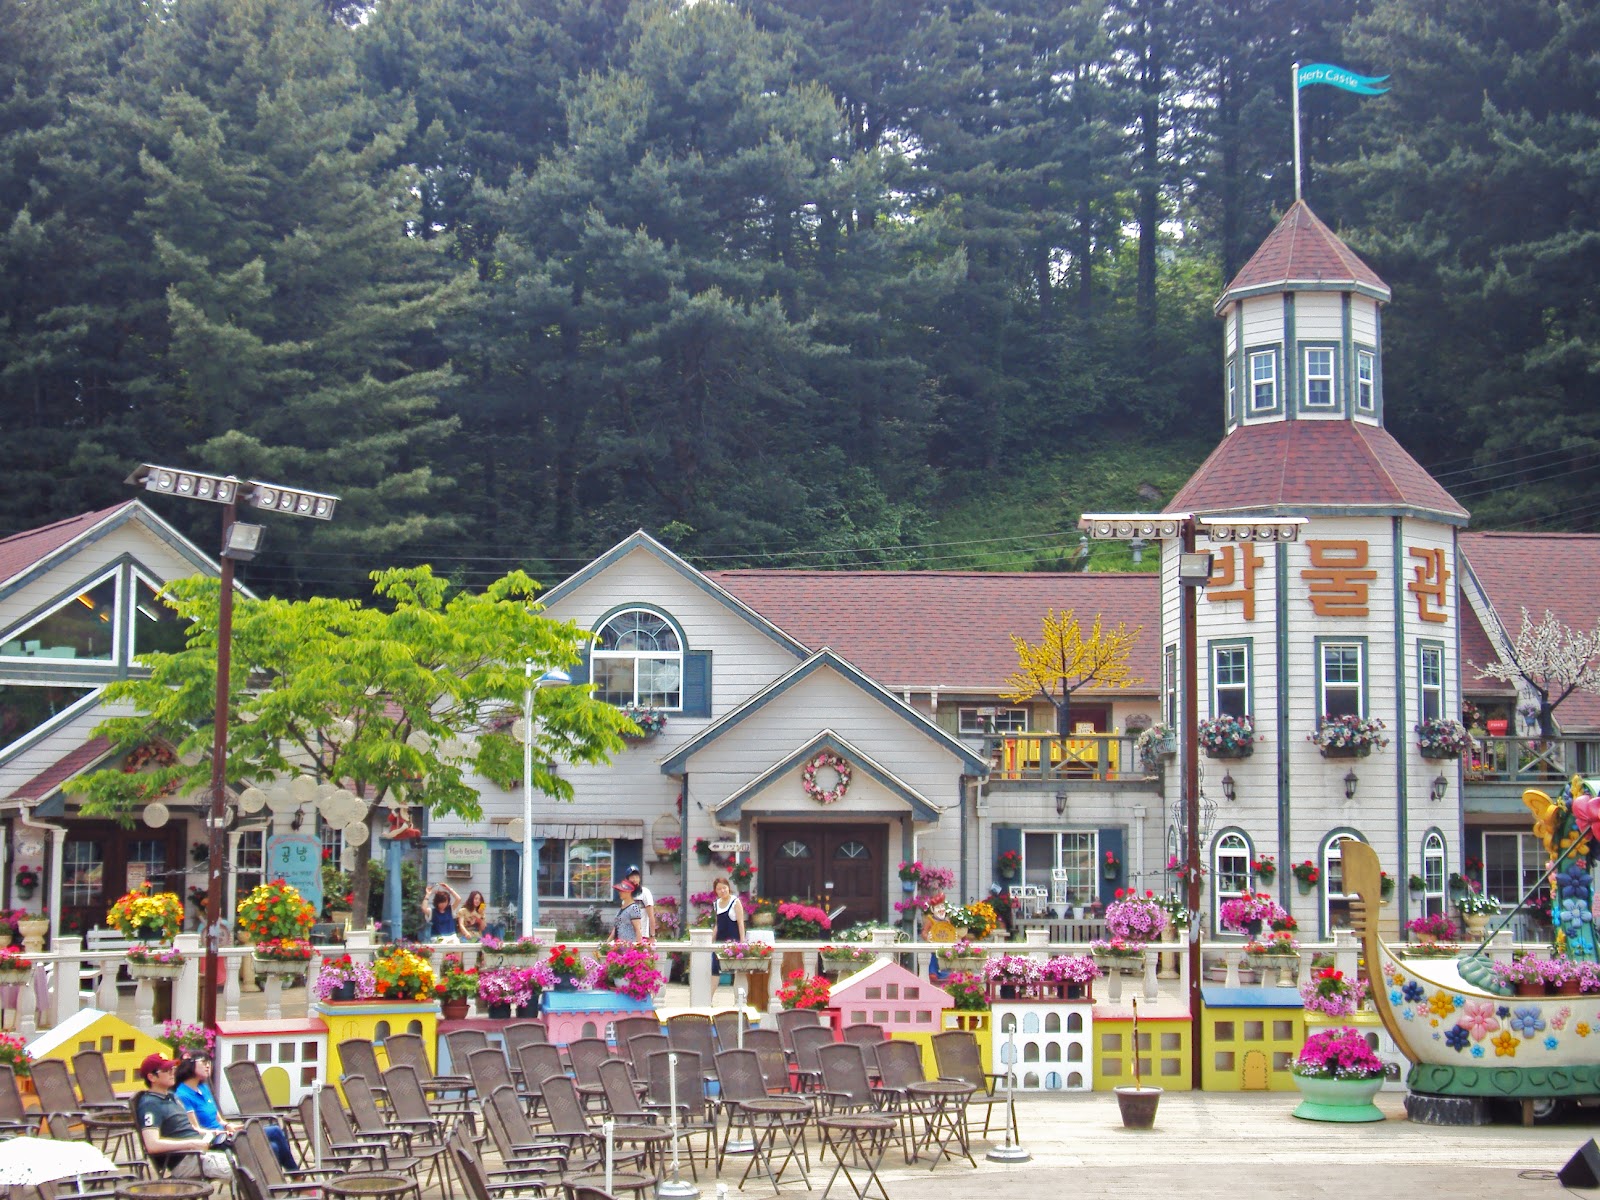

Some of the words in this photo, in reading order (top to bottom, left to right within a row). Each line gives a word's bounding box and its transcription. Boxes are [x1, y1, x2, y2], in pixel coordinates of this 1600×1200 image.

[1300, 69, 1323, 82] Herb
[1325, 70, 1358, 87] Castle
[1197, 540, 1451, 623] 박물관
[144, 1113, 153, 1127] 3
